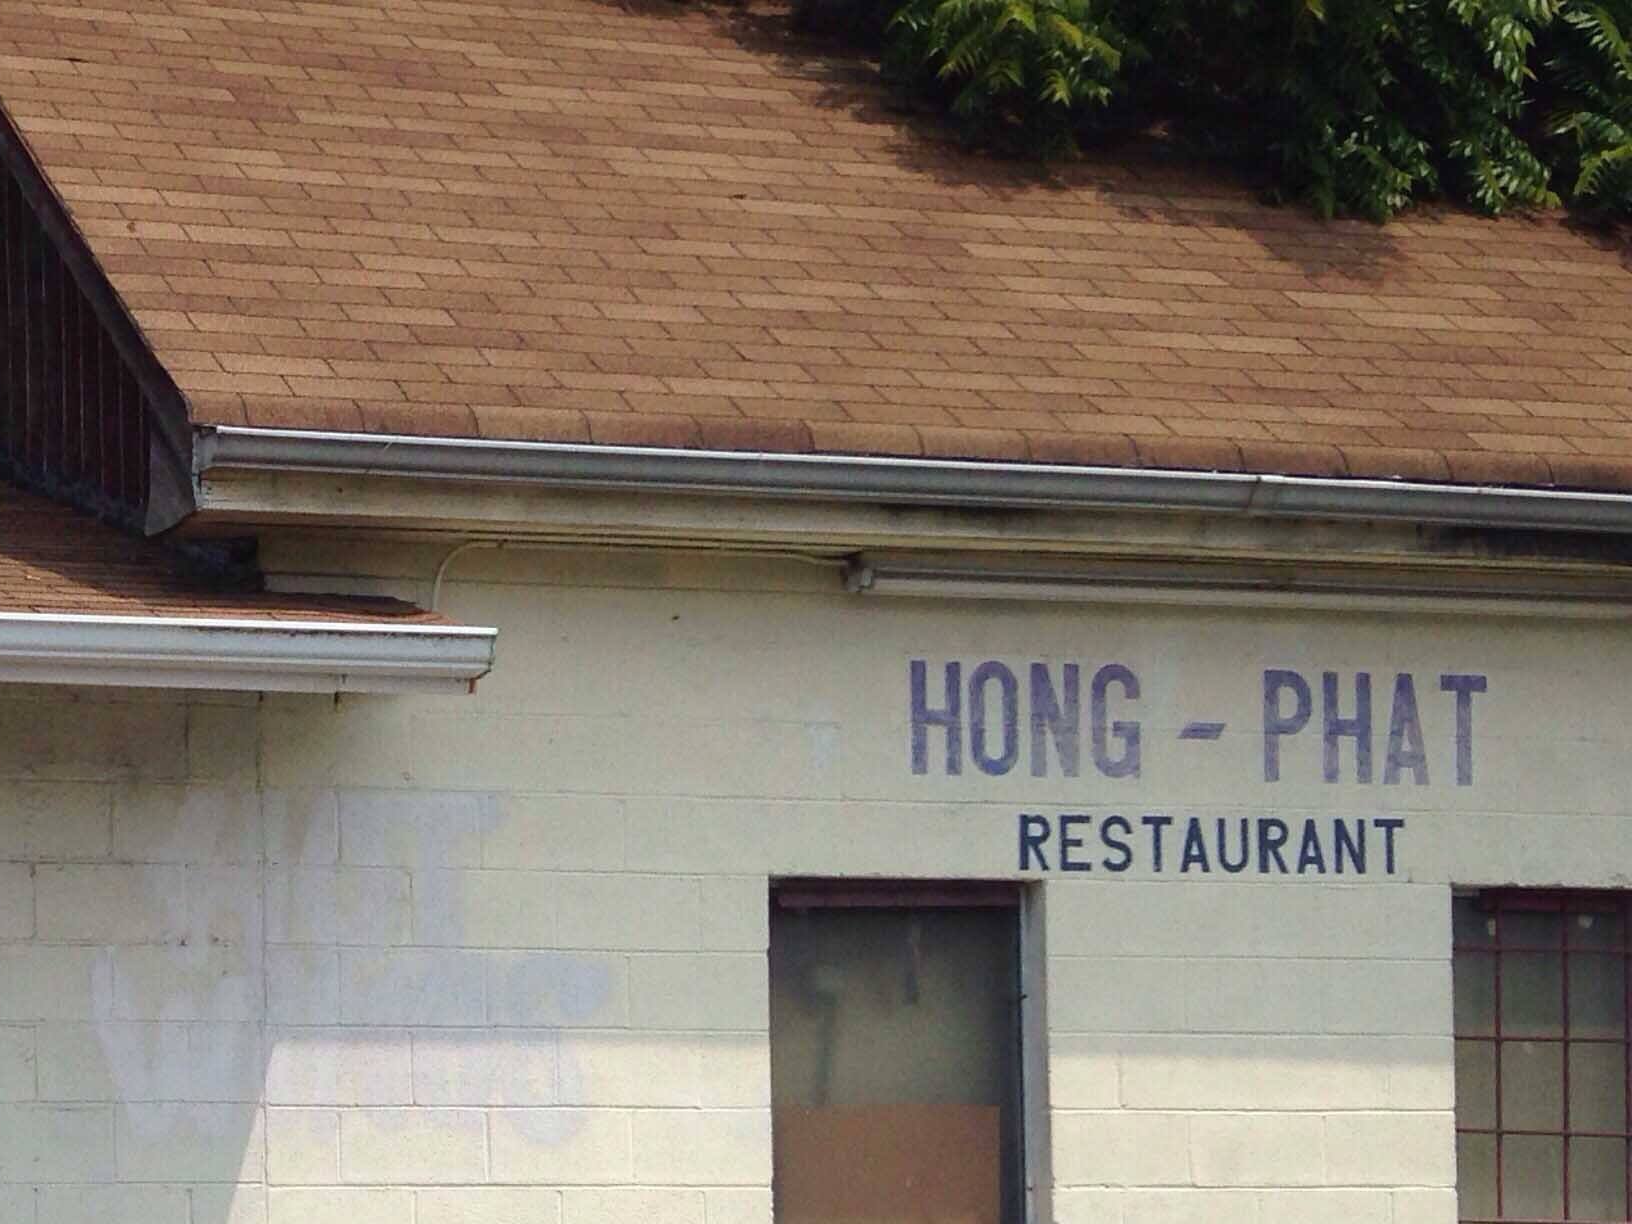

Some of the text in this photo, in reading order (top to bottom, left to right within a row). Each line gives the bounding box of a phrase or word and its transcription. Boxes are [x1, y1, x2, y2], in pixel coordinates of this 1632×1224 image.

[910, 659, 1142, 779] HONG
[1262, 668, 1488, 786] PHAT
[1017, 813, 1405, 875] RESTAURANT
